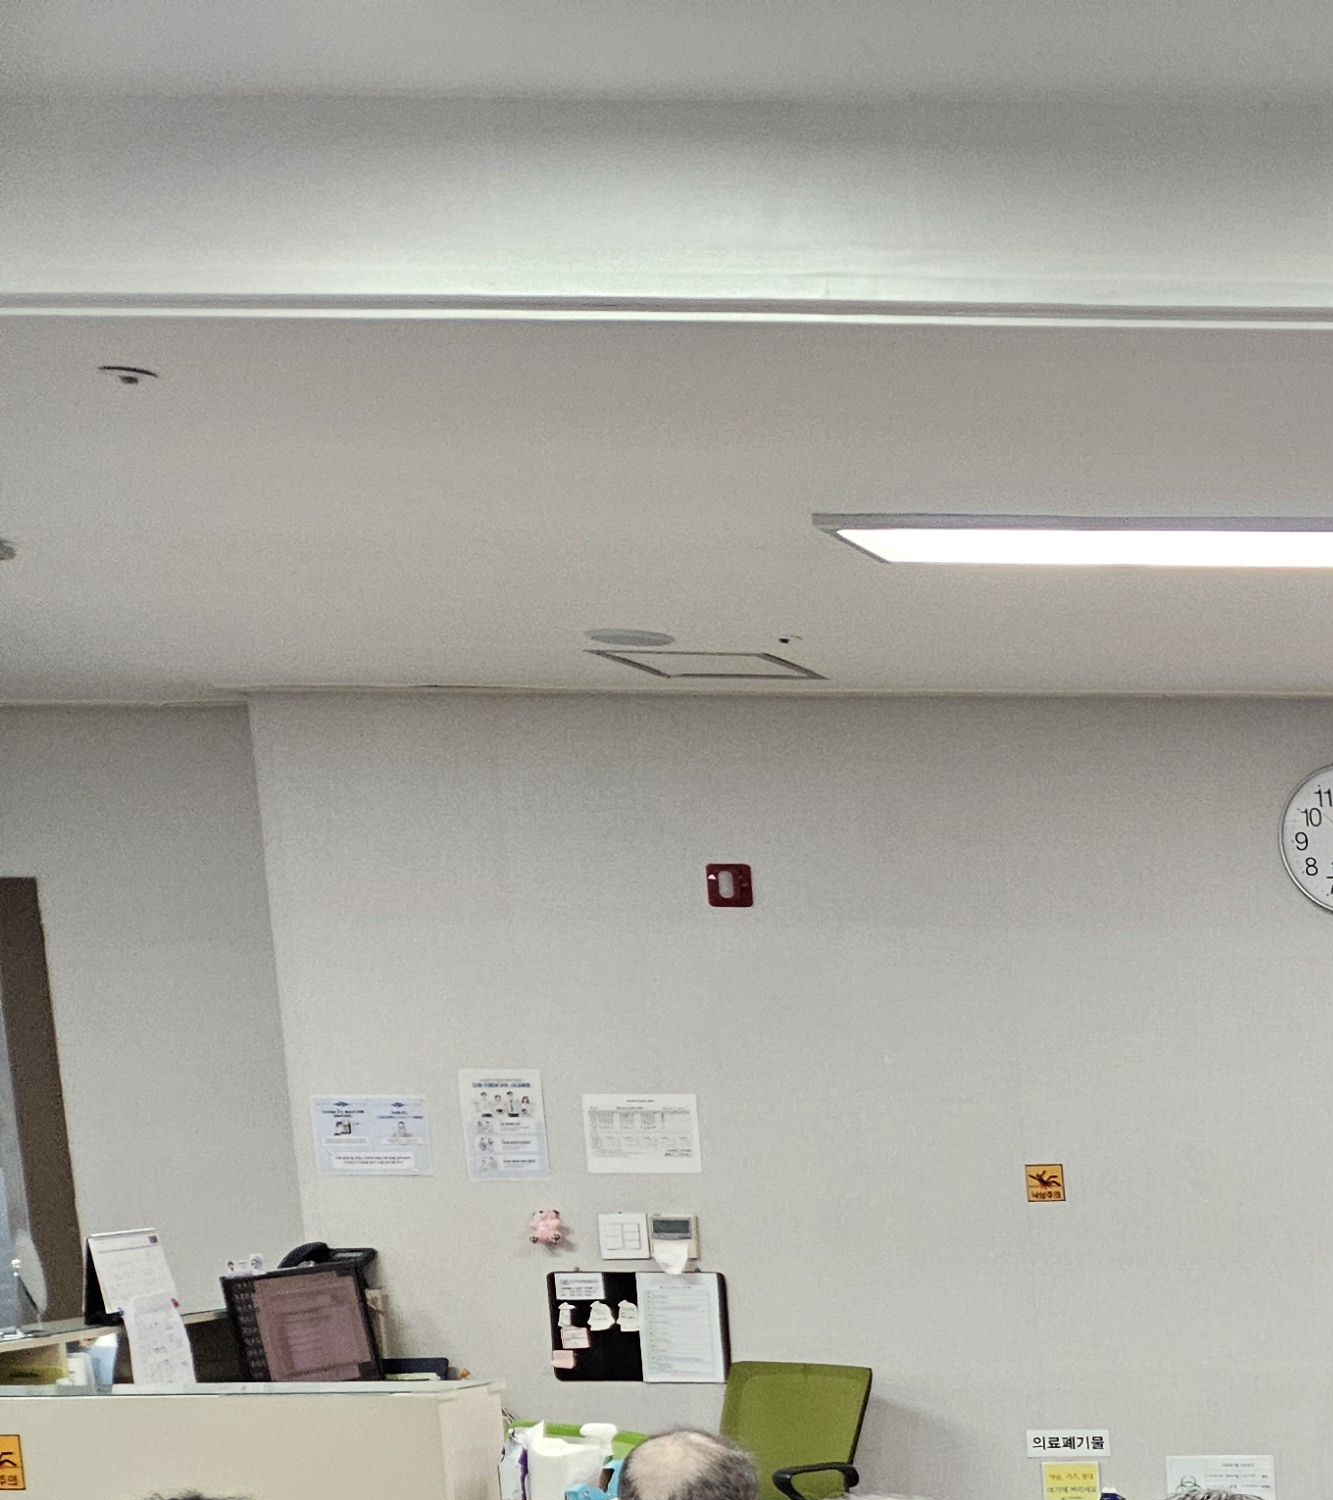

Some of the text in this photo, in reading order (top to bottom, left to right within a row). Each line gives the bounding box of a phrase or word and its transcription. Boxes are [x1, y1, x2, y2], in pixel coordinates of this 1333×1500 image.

[1314, 788, 1332, 807] 11
[1300, 807, 1322, 827] 10
[1294, 831, 1308, 851] 9
[1305, 857, 1319, 876] 8
[1032, 1436, 1104, 1450] 의료폐기물
